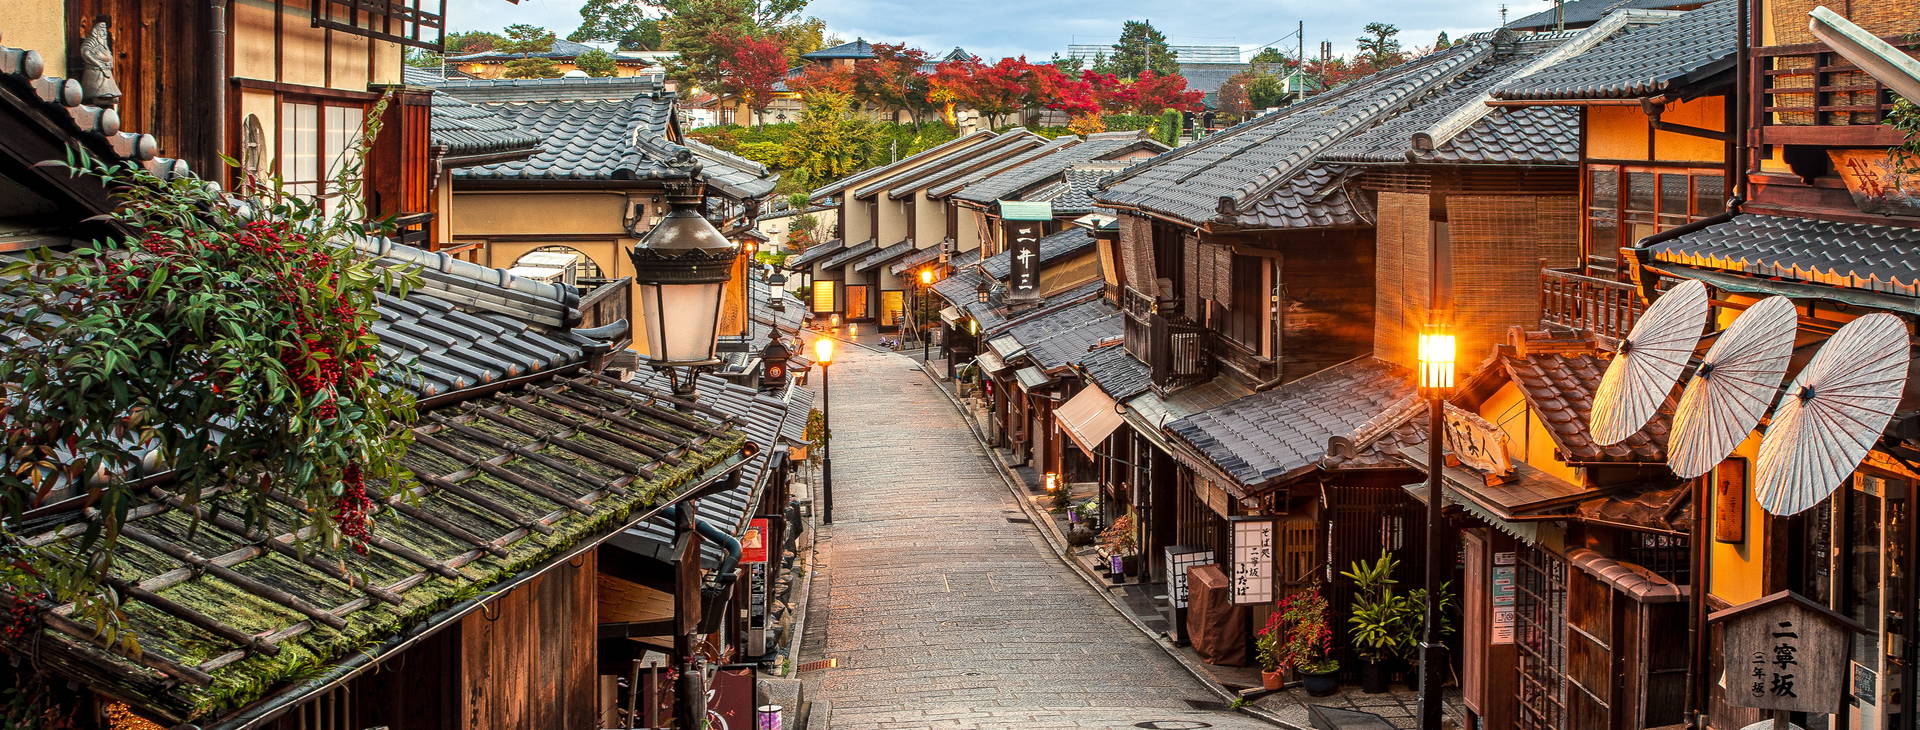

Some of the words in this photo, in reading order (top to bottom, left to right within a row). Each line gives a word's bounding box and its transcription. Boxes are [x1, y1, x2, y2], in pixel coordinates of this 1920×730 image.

[1017, 222, 1037, 290] 二井三
[1261, 528, 1271, 558] そば処
[1236, 563, 1250, 596] ふたば
[1770, 621, 1799, 698] 二寧坂
